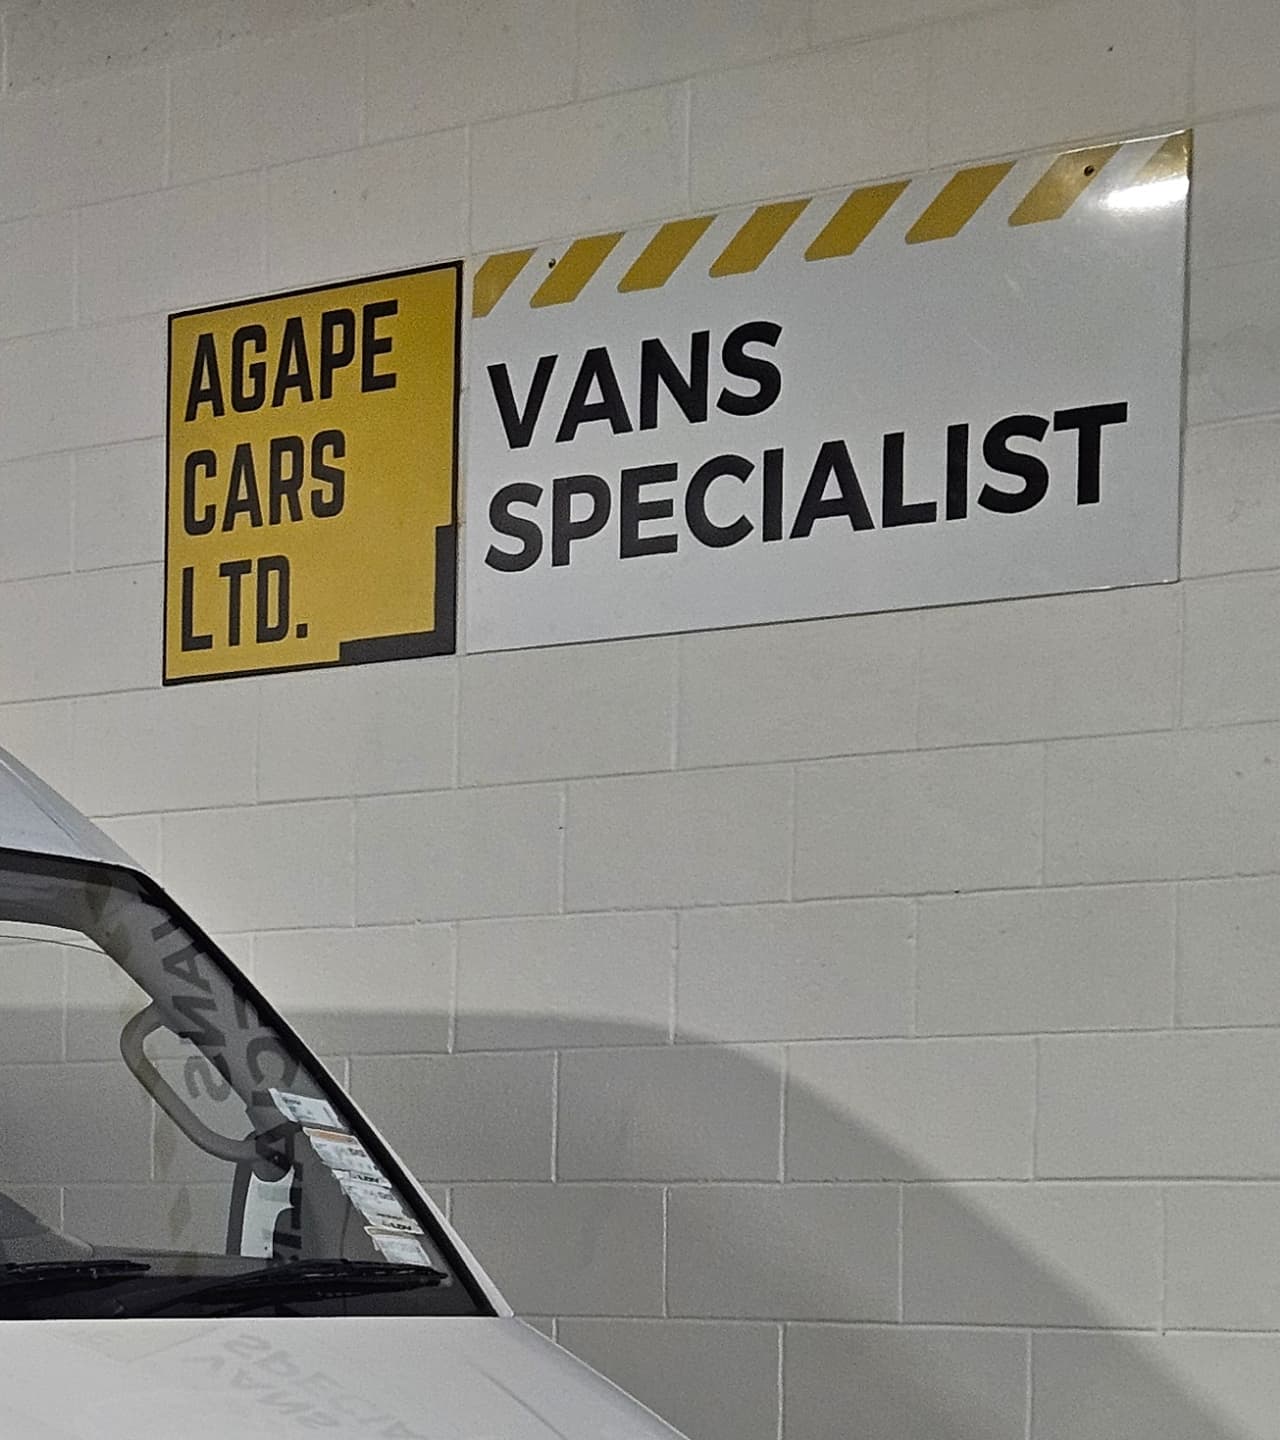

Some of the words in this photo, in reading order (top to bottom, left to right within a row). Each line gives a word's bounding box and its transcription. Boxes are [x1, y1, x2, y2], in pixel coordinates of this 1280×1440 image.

[183, 299, 399, 423] AGAPE
[487, 321, 783, 450] VANS
[182, 429, 346, 537] CARS
[484, 402, 1129, 573] SPECIALIST
[180, 554, 309, 652] LTD.
